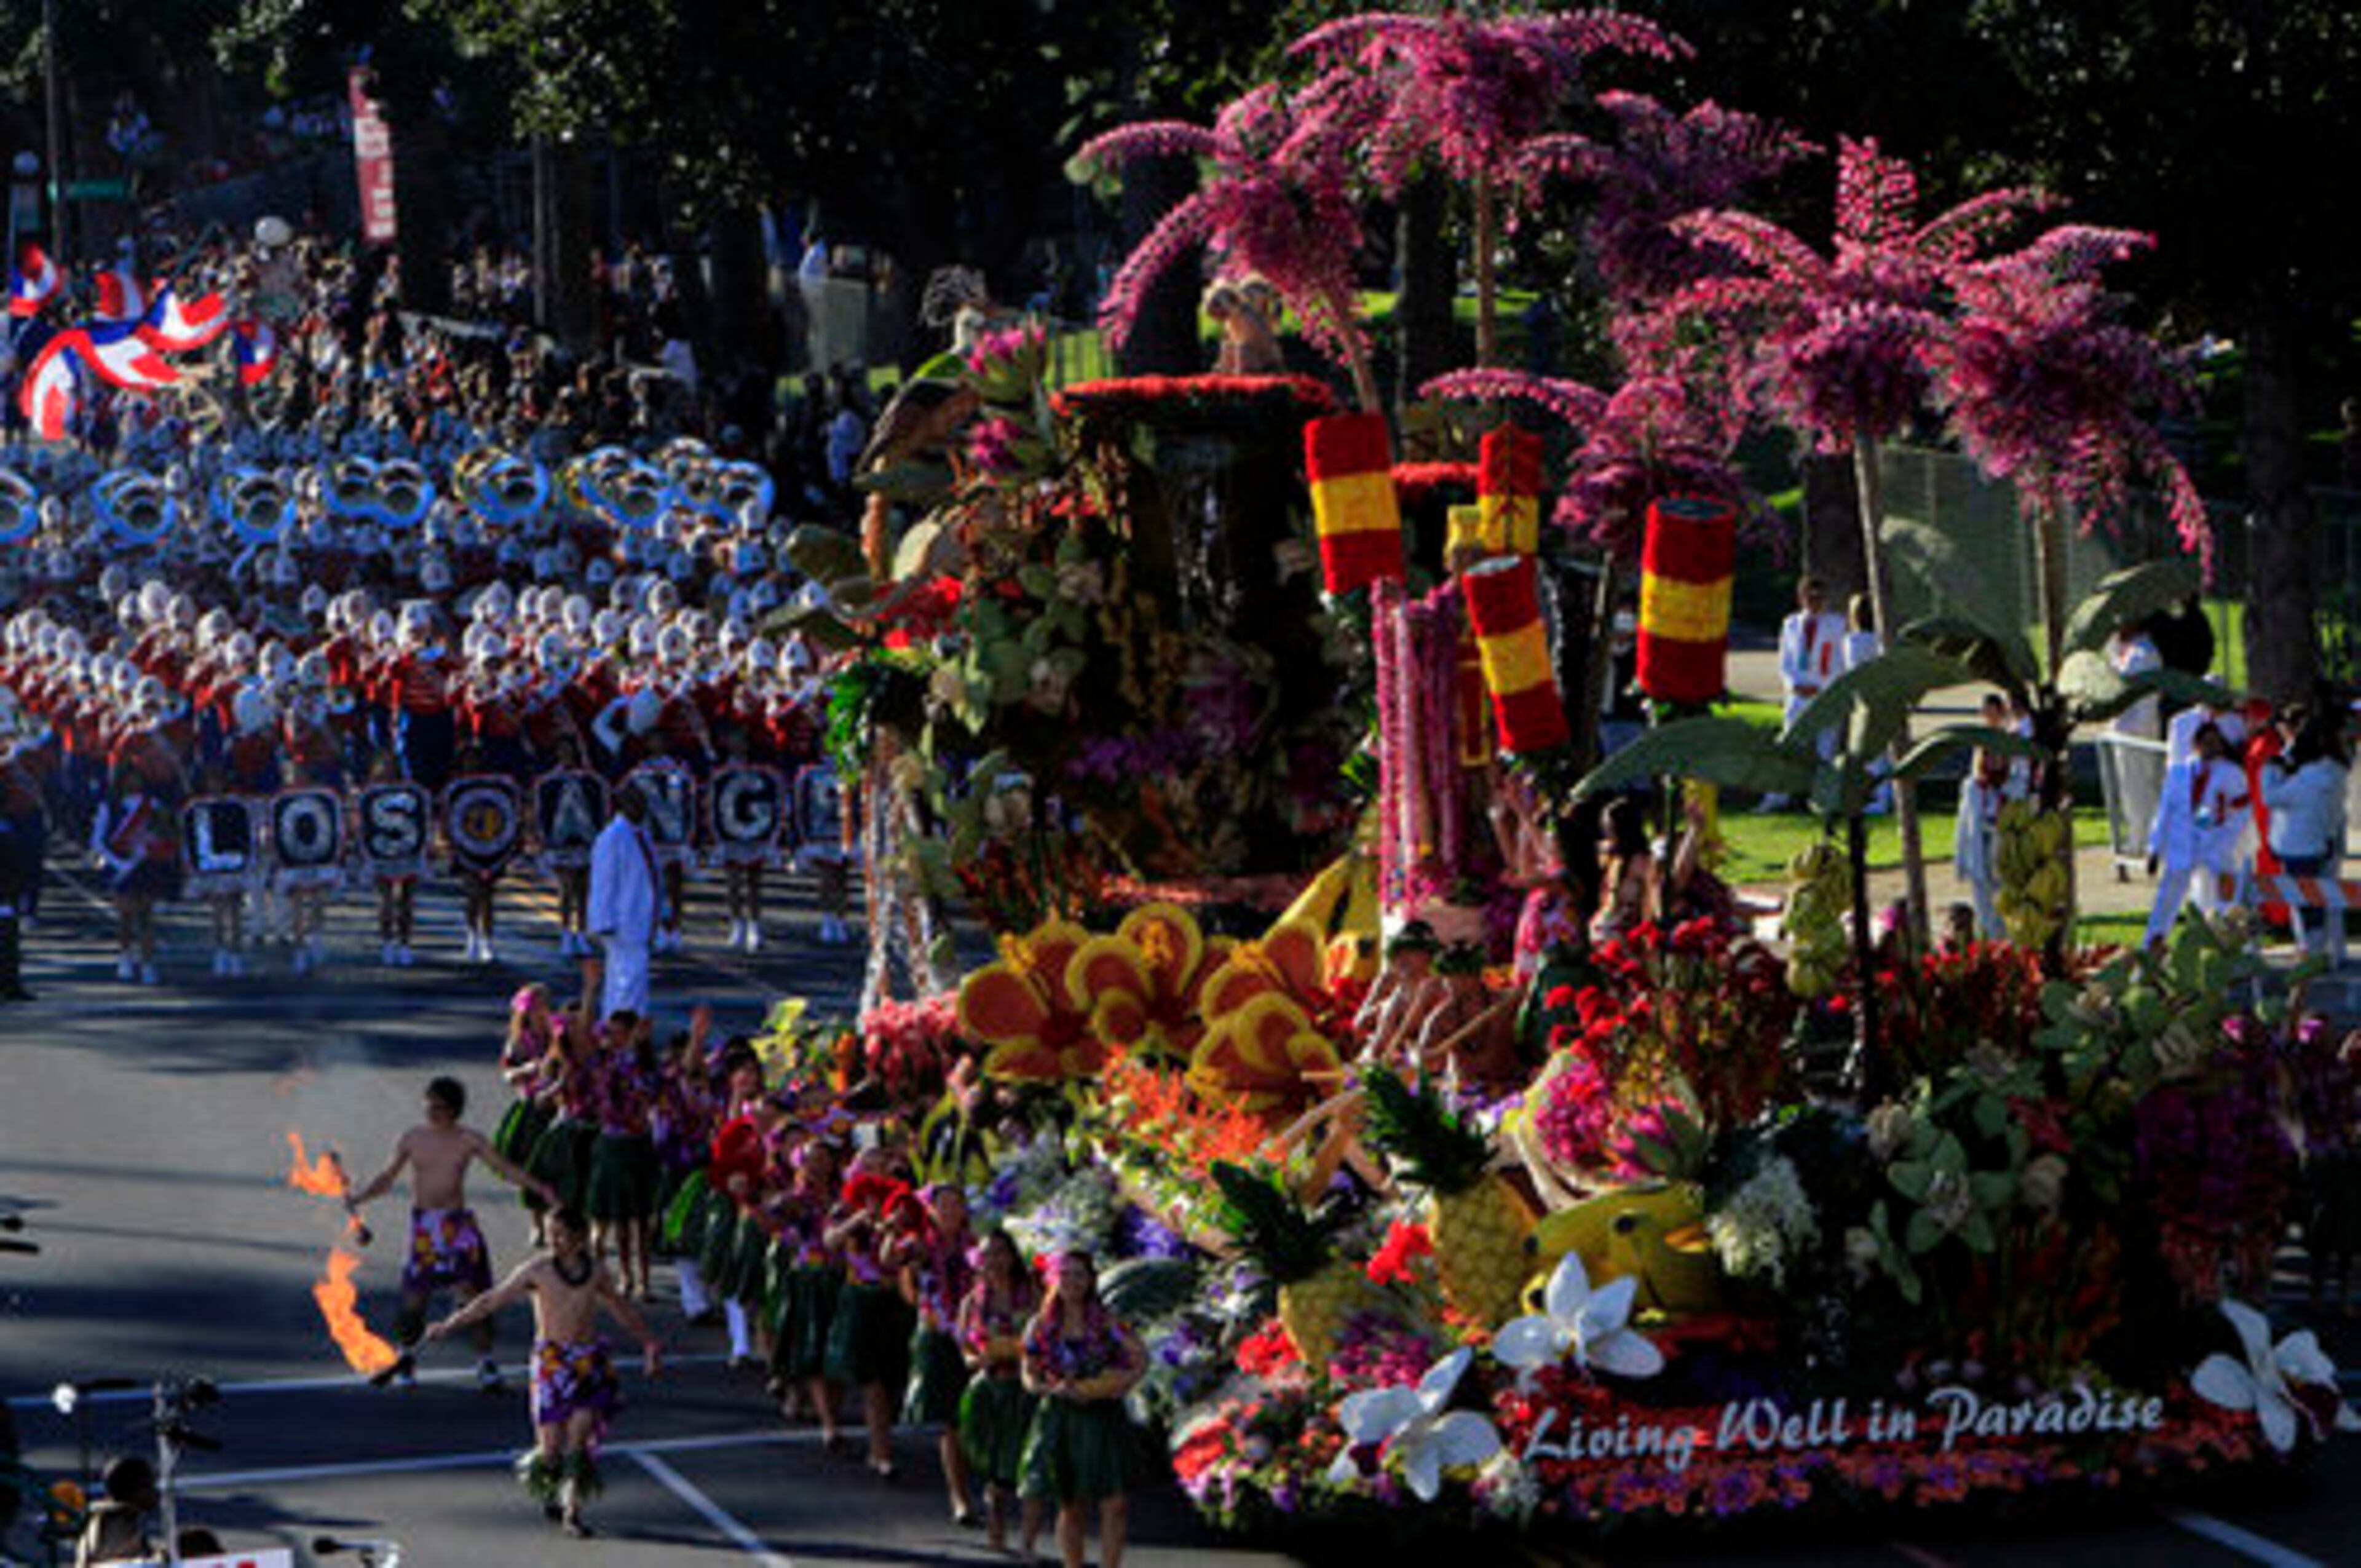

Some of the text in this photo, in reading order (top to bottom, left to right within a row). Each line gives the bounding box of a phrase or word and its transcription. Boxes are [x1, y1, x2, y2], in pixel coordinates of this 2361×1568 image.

[192, 792, 420, 871] LOS
[1522, 1382, 2165, 1473] Living Well in Paradise
